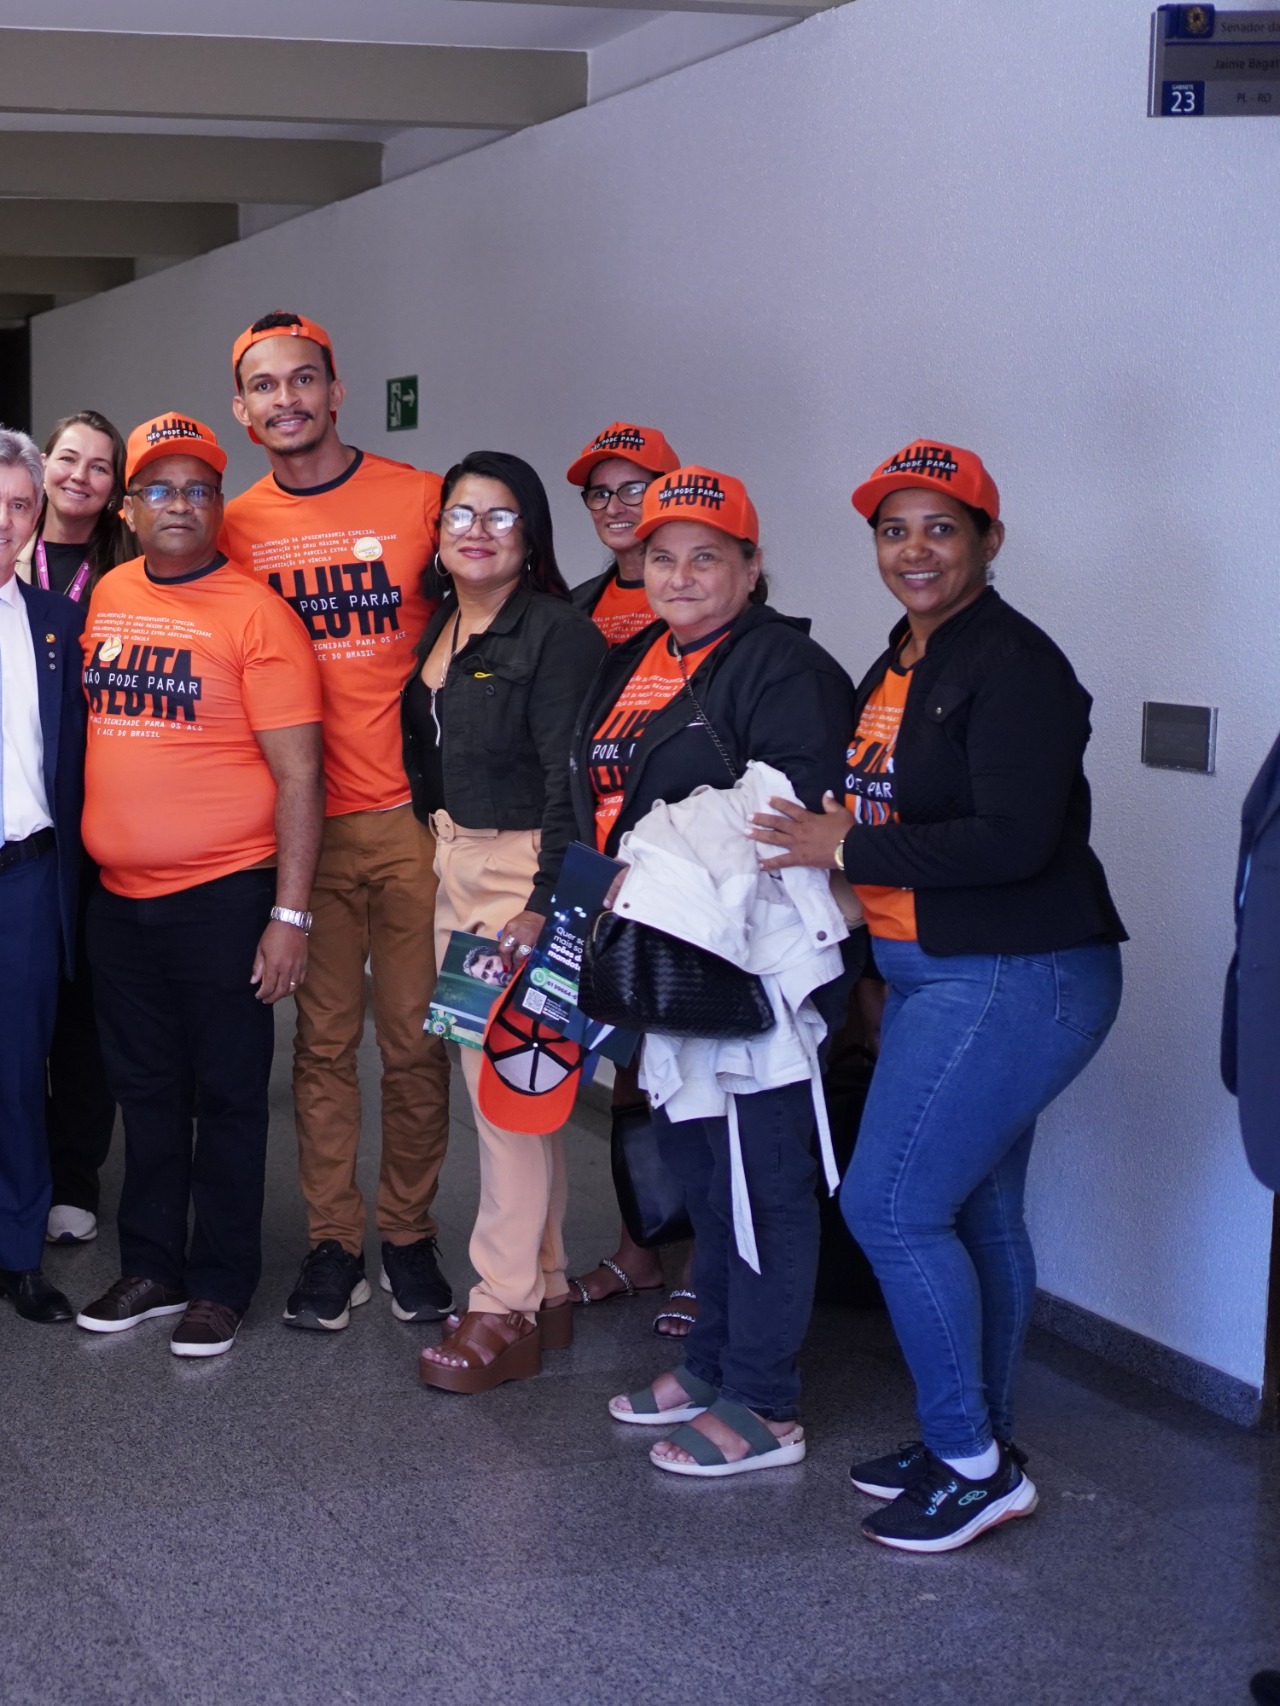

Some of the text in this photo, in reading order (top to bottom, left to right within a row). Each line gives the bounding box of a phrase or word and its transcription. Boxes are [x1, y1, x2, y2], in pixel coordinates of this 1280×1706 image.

[1221, 21, 1264, 33] Senador
[1214, 58, 1246, 70] Jaime
[1171, 91, 1195, 112] 23
[1236, 92, 1272, 104] PL RO
[147, 433, 161, 441] NÃO
[620, 436, 644, 444] PARAR
[900, 460, 923, 469] PODE
[925, 459, 957, 471] PARAR
[659, 487, 724, 500] NÃO PODE PARAR
[301, 531, 346, 542] APOSENTADORIA
[347, 528, 376, 536] ESPECIAL
[319, 538, 341, 548] MÁXIMO
[294, 551, 302, 559] DA
[303, 548, 328, 557] PARCELA
[329, 546, 348, 554] EXTRA
[307, 556, 333, 564] VÍNCULO
[299, 591, 400, 613] PODE PARAR
[313, 631, 407, 651] IGNIDADE PARA OS ACS
[331, 652, 342, 660] DO
[345, 650, 377, 659] BRASIL
[84, 669, 199, 695] NÃO PODE PARAR
[103, 717, 141, 727] DIGNIDADE
[144, 720, 166, 728] PARA
[102, 728, 115, 736] ACE
[117, 729, 127, 737] DO
[130, 729, 161, 738] BRASIL
[591, 743, 620, 760] PODE
[556, 926, 577, 940] Quer
[553, 935, 574, 950] mais
[550, 942, 575, 959] ações
